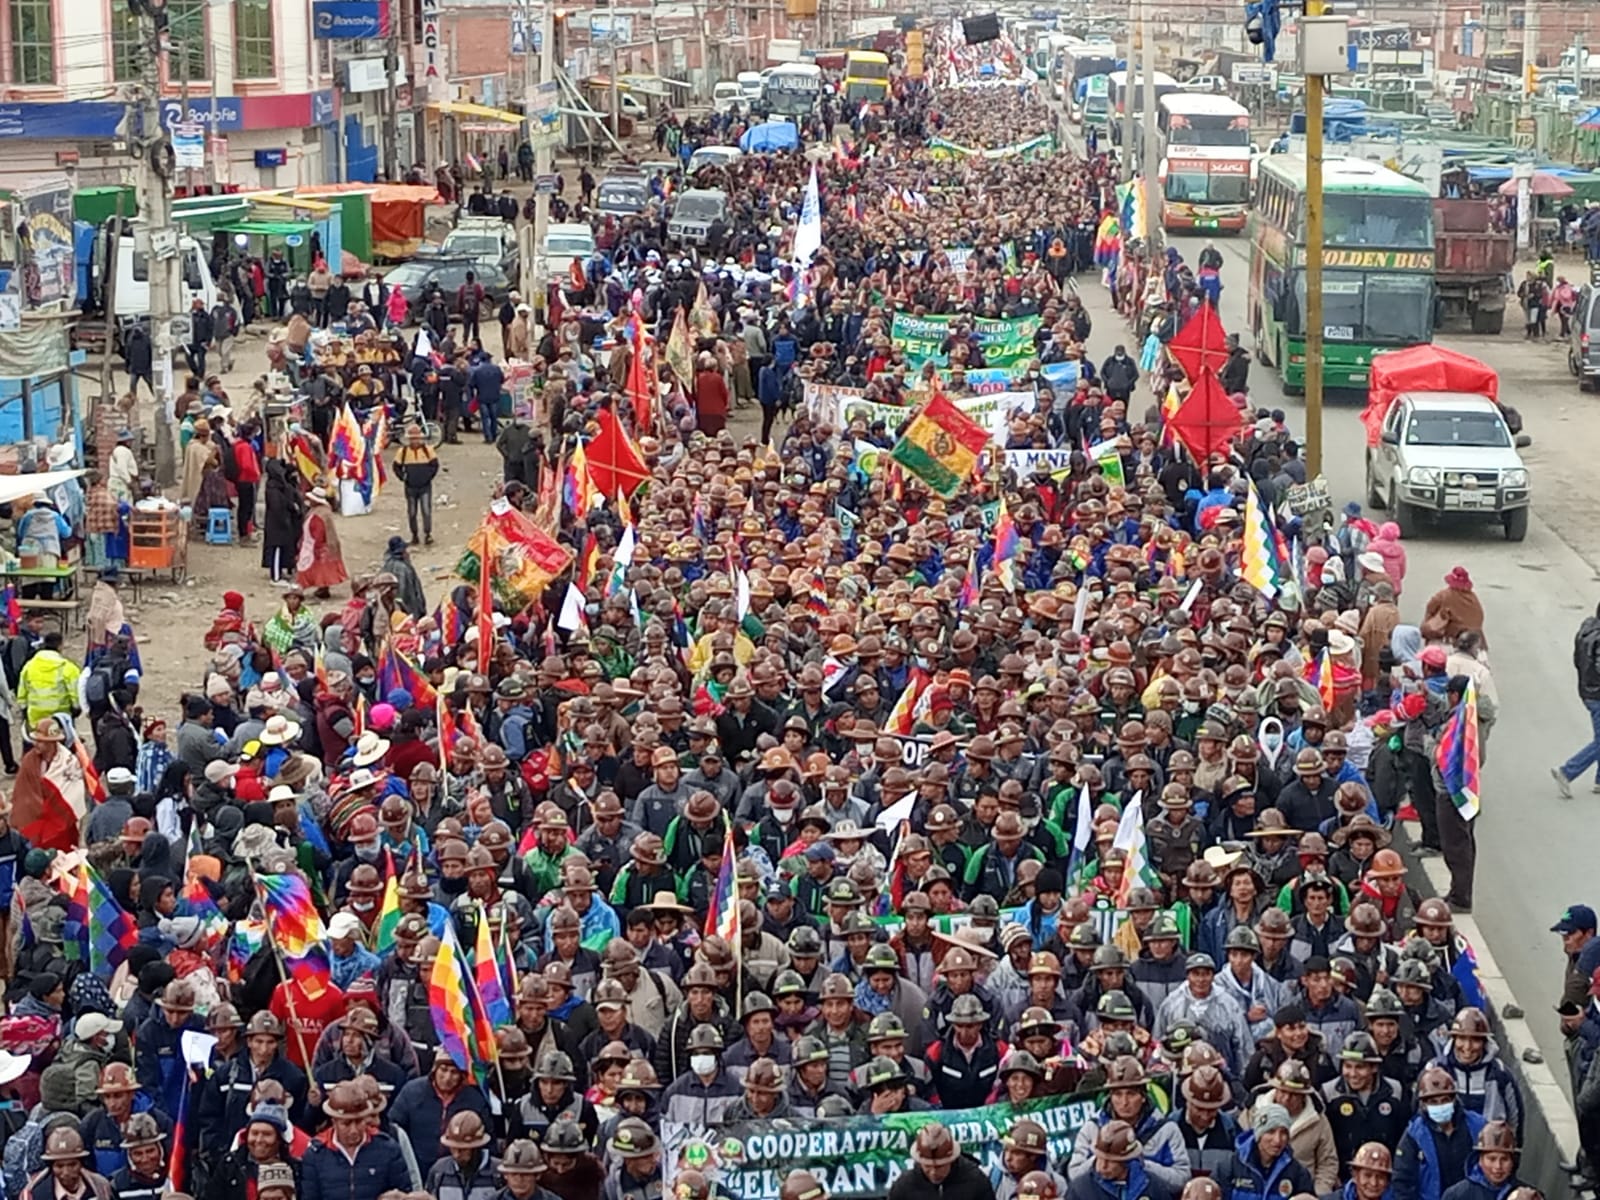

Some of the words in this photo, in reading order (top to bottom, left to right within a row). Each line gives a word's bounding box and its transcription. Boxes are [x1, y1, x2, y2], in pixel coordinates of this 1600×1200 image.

[188, 108, 236, 122] BanoFie
[1322, 251, 1388, 267] OLDEN
[1393, 252, 1431, 268] BUS
[1026, 450, 1069, 467] MINE
[747, 1131, 908, 1161] COOPERATIVA
[814, 1159, 877, 1193] RAN
